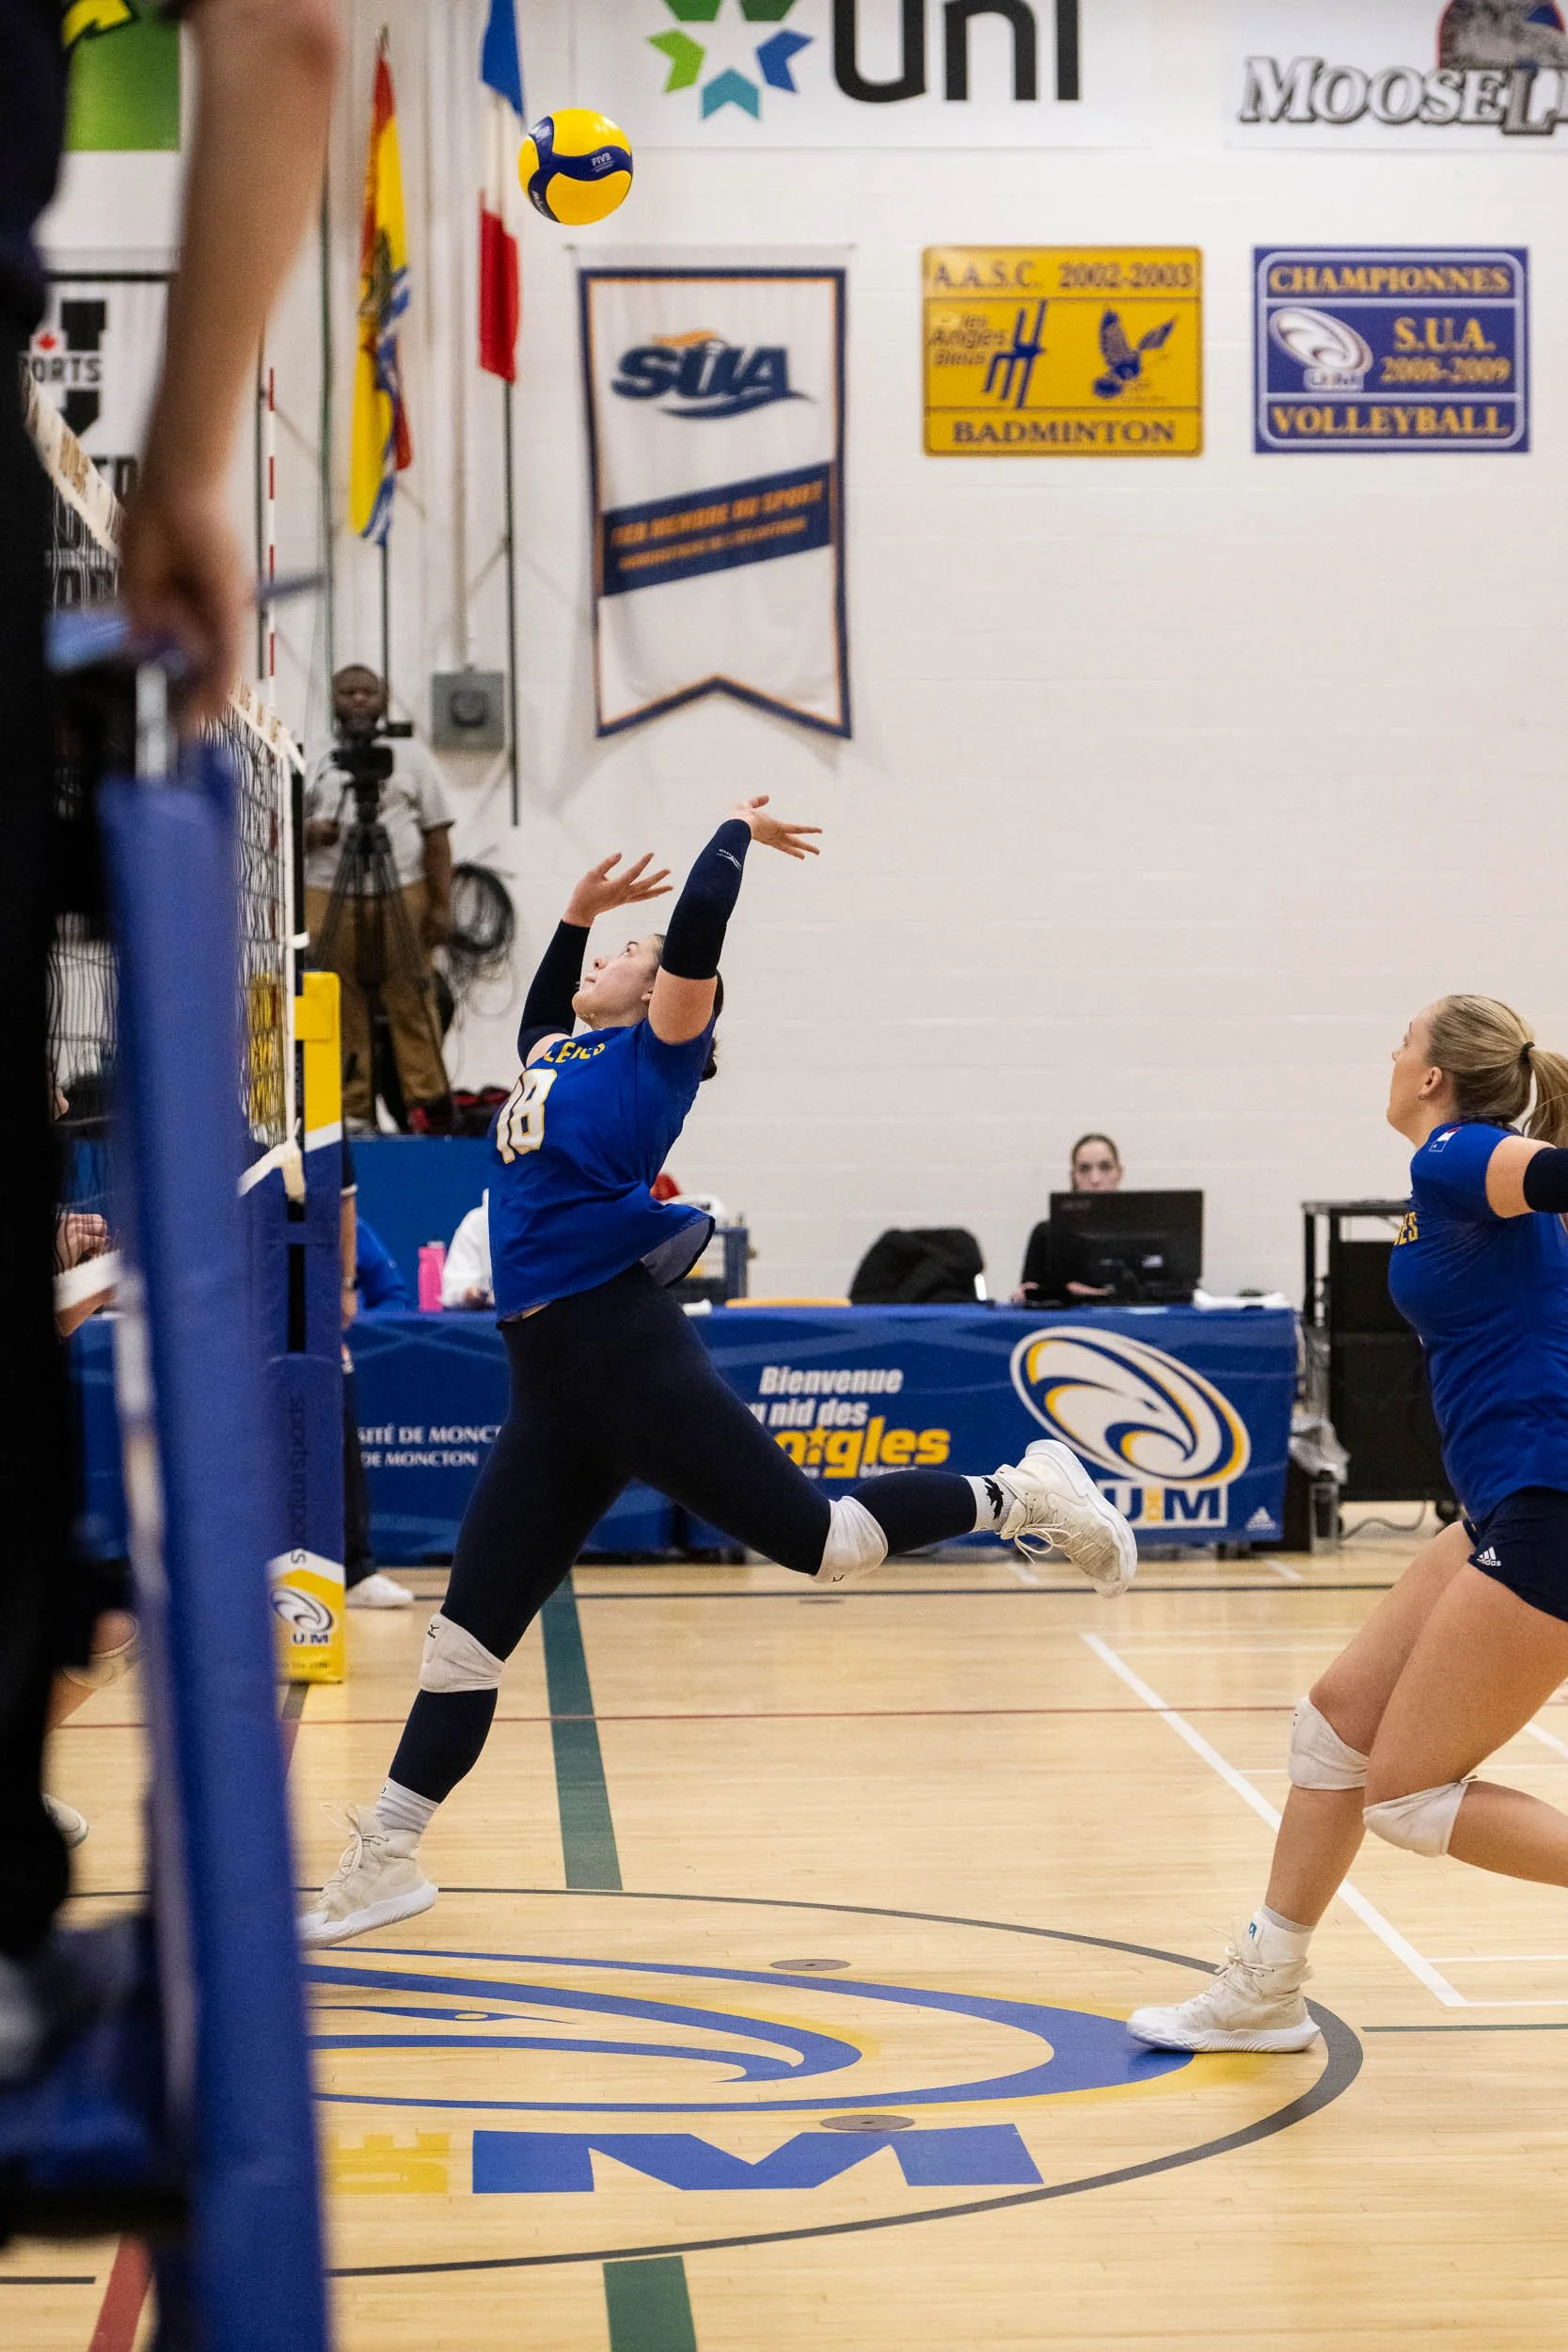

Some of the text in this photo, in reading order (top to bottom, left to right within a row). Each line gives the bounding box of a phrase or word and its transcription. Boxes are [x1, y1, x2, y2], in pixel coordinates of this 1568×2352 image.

[591, 152, 611, 167] FIVB
[1058, 262, 1193, 289] 2002-2003
[1270, 266, 1510, 293] CHAMPIONNES
[1394, 317, 1497, 352] S.U.A.
[612, 341, 795, 405] SUA
[954, 421, 1174, 444] BADMINTON
[1274, 406, 1510, 435] VOLLEYBALL
[758, 1365, 904, 1394] Bienvenue
[768, 1399, 816, 1426] nid
[816, 1398, 869, 1426] des
[398, 1426, 423, 1445] DE
[385, 1450, 479, 1468] MONCTON
